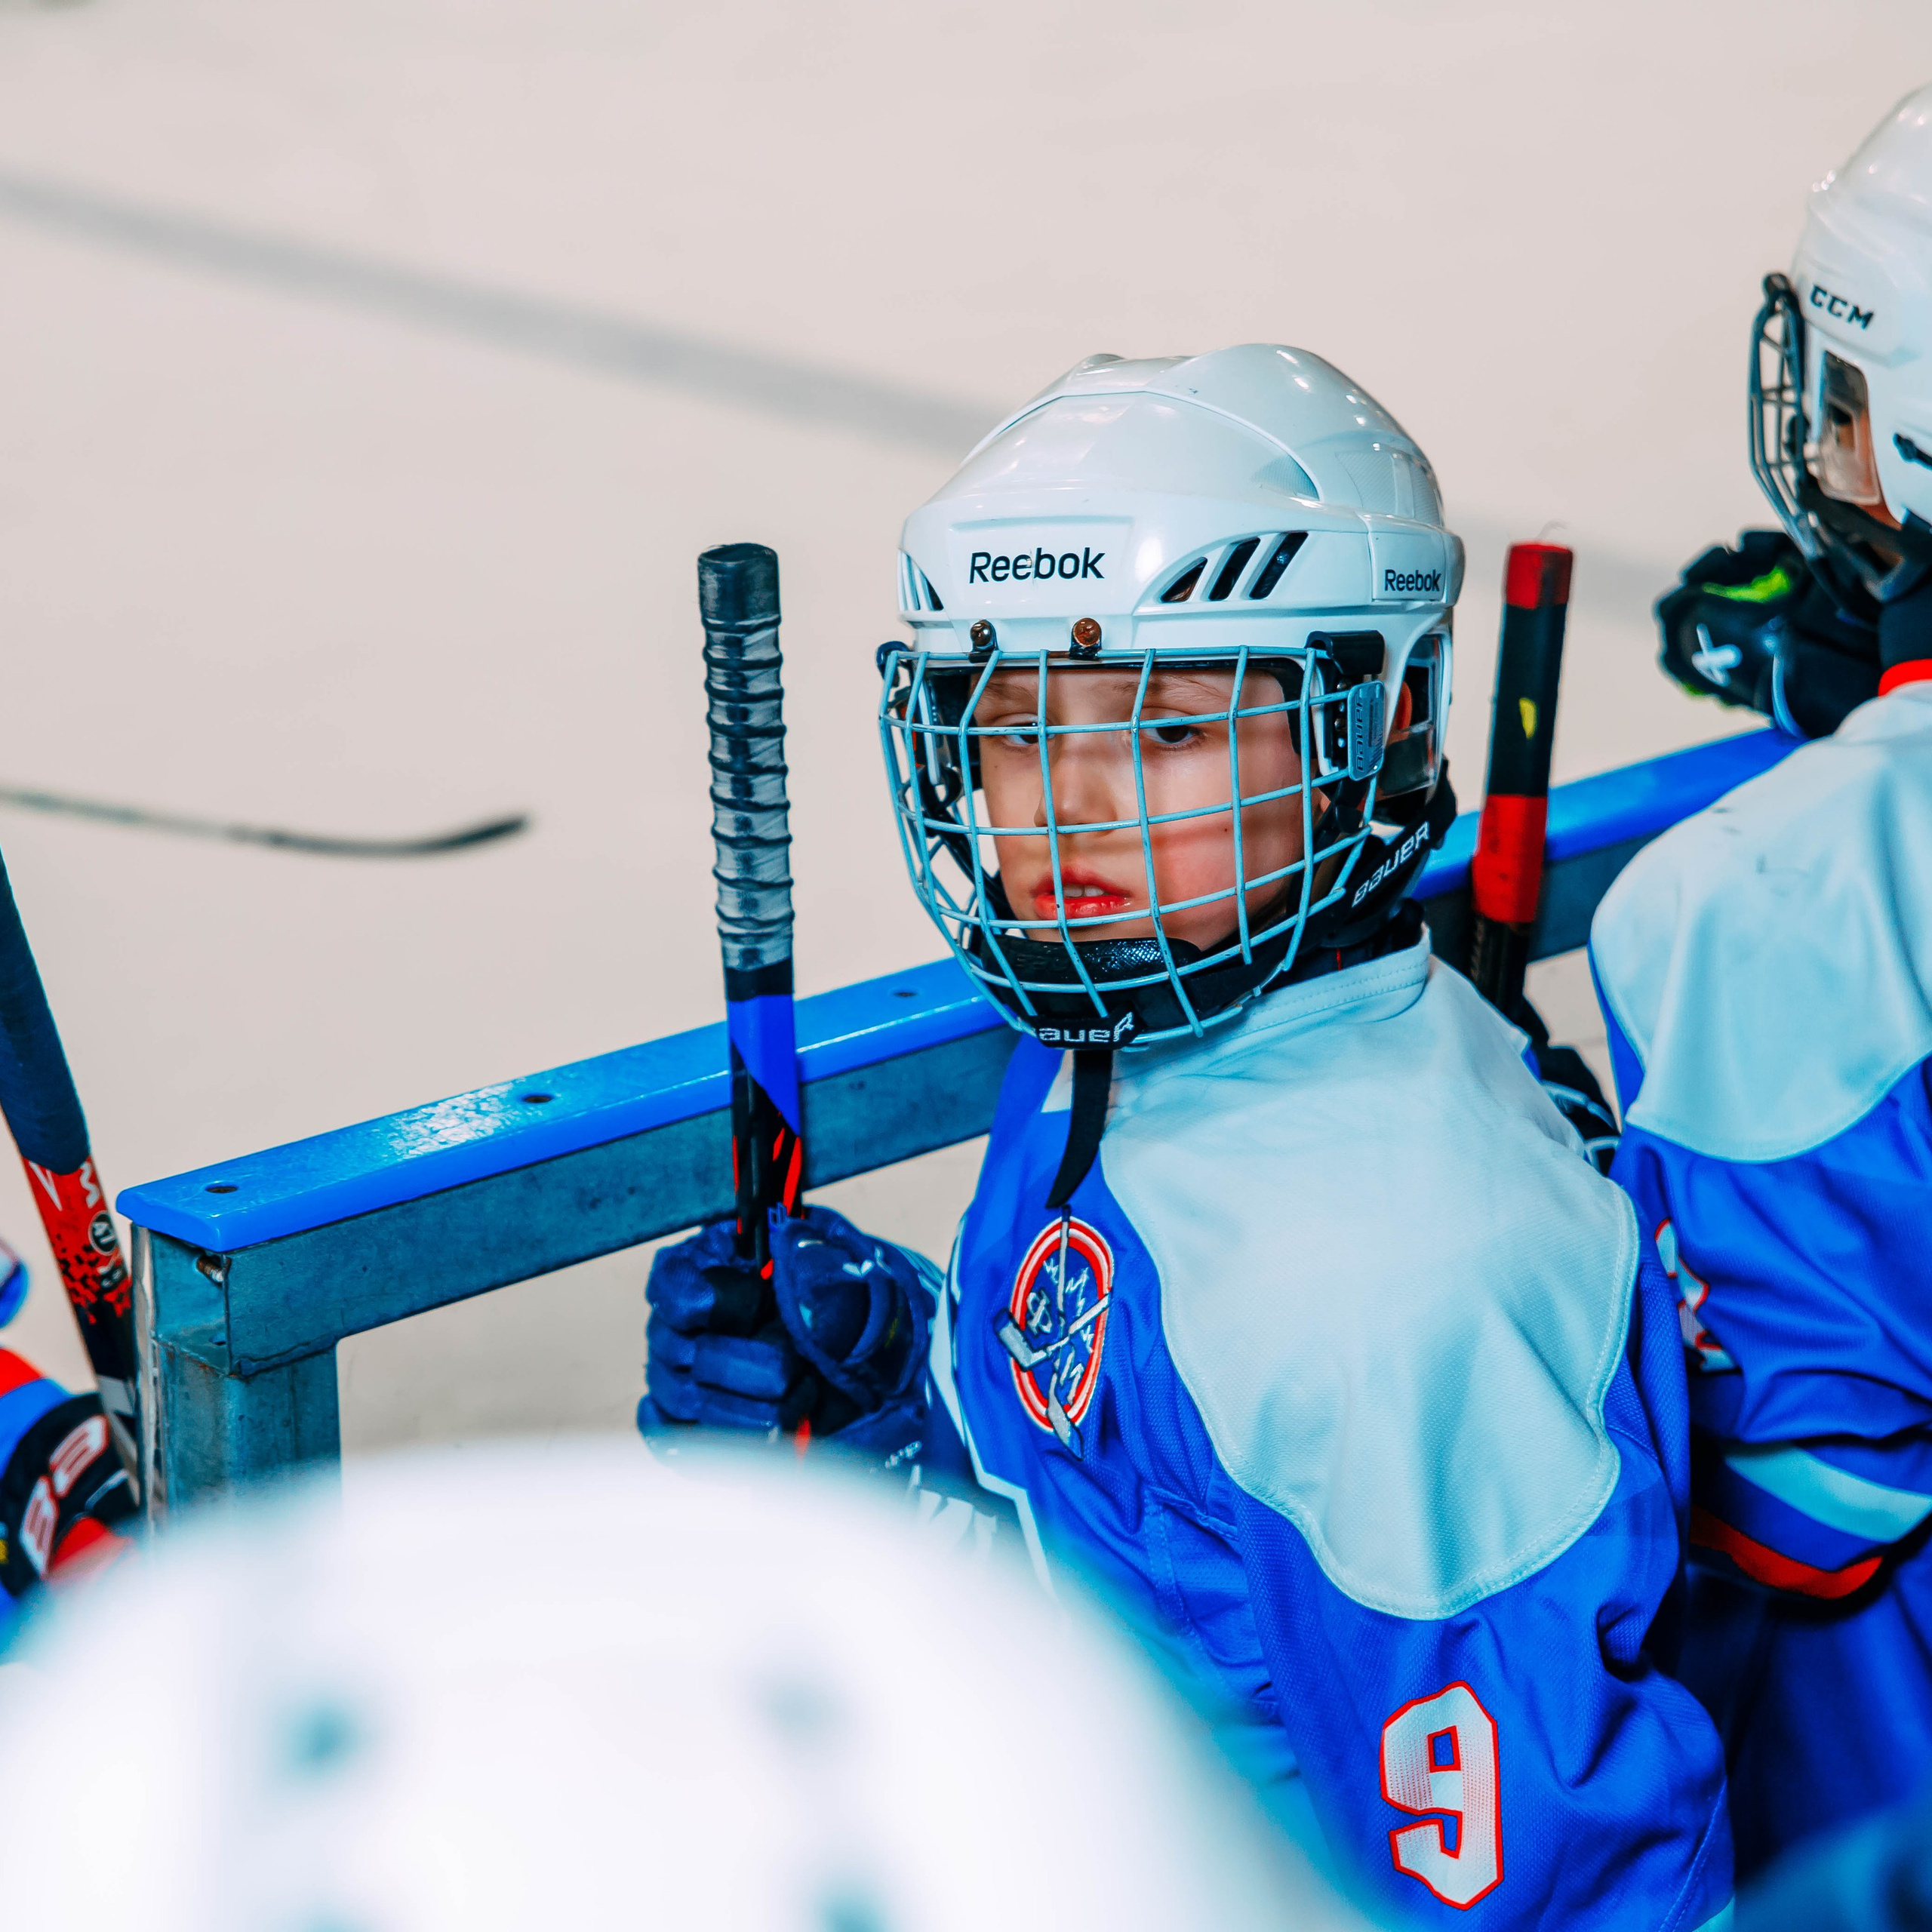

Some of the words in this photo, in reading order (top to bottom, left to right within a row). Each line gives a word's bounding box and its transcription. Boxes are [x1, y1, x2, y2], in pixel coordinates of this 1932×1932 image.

[1810, 285, 1874, 329] CCM
[969, 547, 1106, 583] Reebok
[1384, 569, 1441, 592] Reebok
[1380, 1680, 1504, 1911] 9
